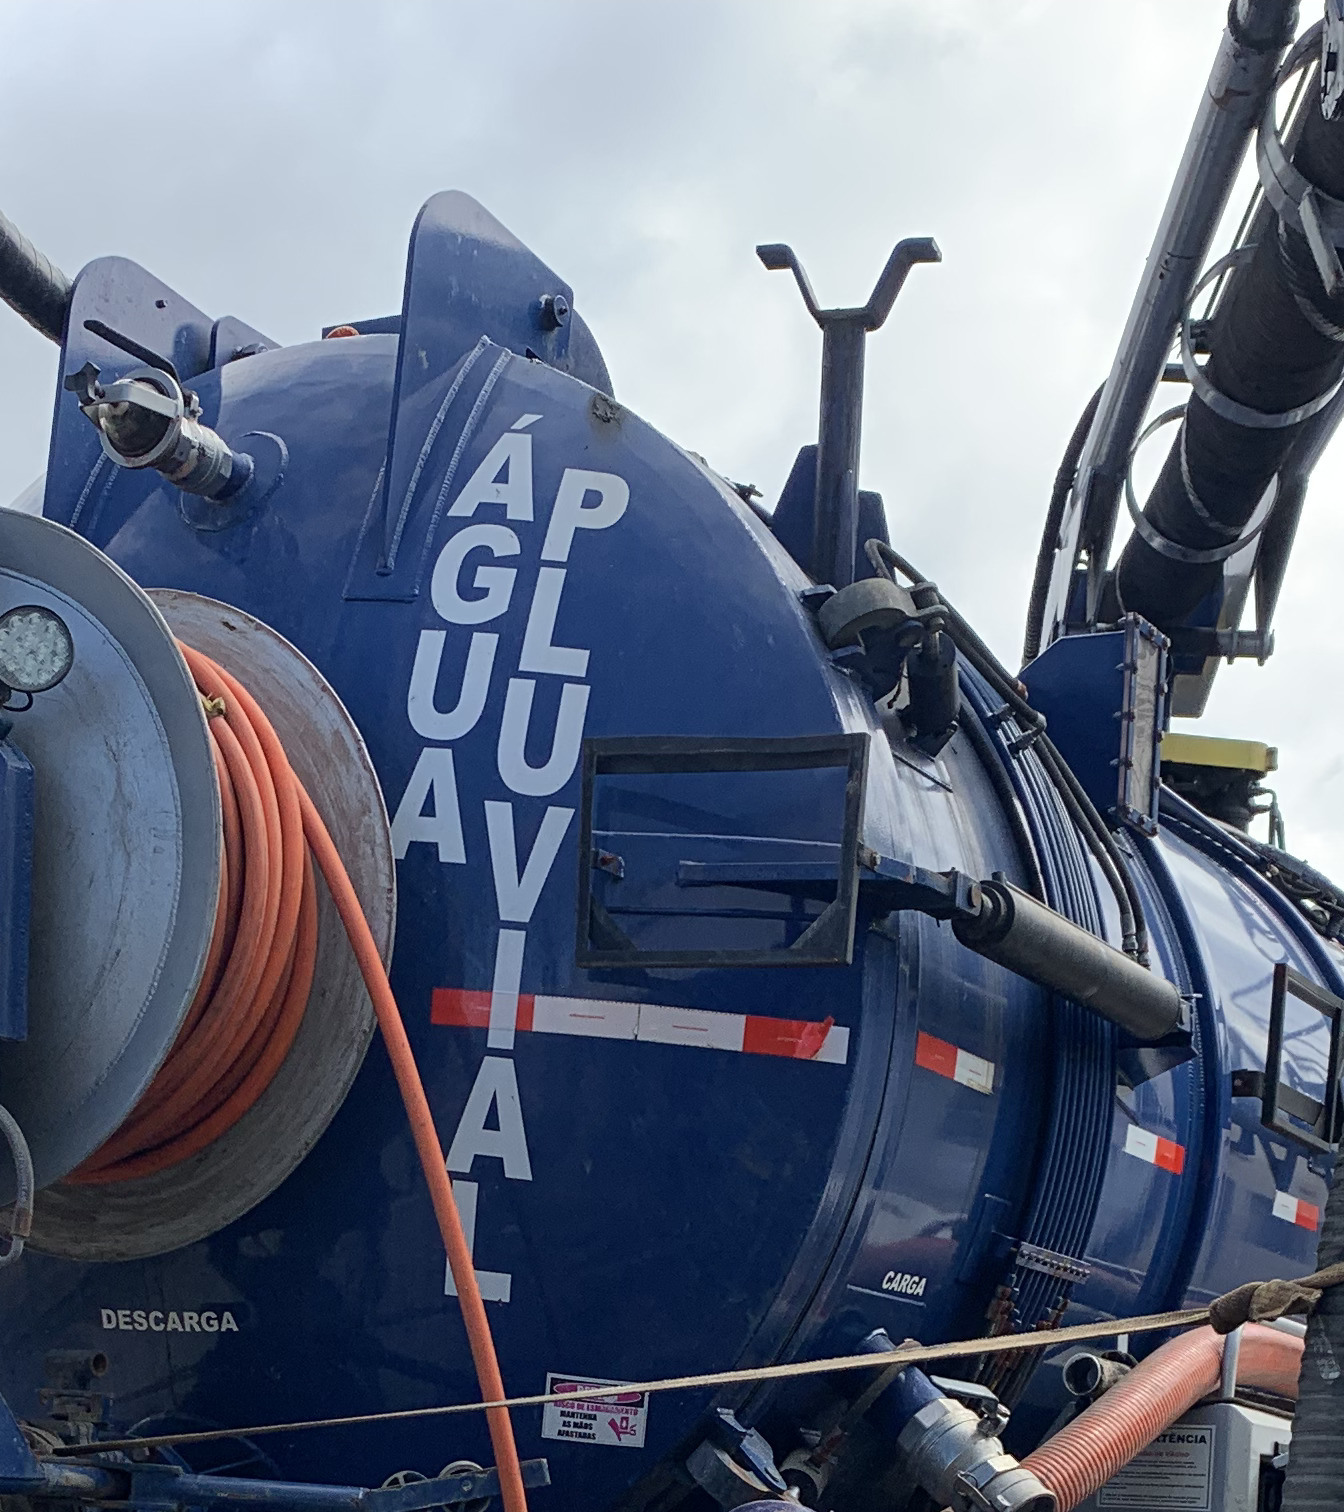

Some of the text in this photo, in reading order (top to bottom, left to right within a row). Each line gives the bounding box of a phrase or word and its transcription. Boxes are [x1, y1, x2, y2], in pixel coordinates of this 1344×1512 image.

[391, 414, 543, 864] ÁGUA
[444, 468, 630, 1302] PLUVIAL
[101, 1309, 239, 1332] DESCARGA
[882, 1271, 927, 1296] CARGA
